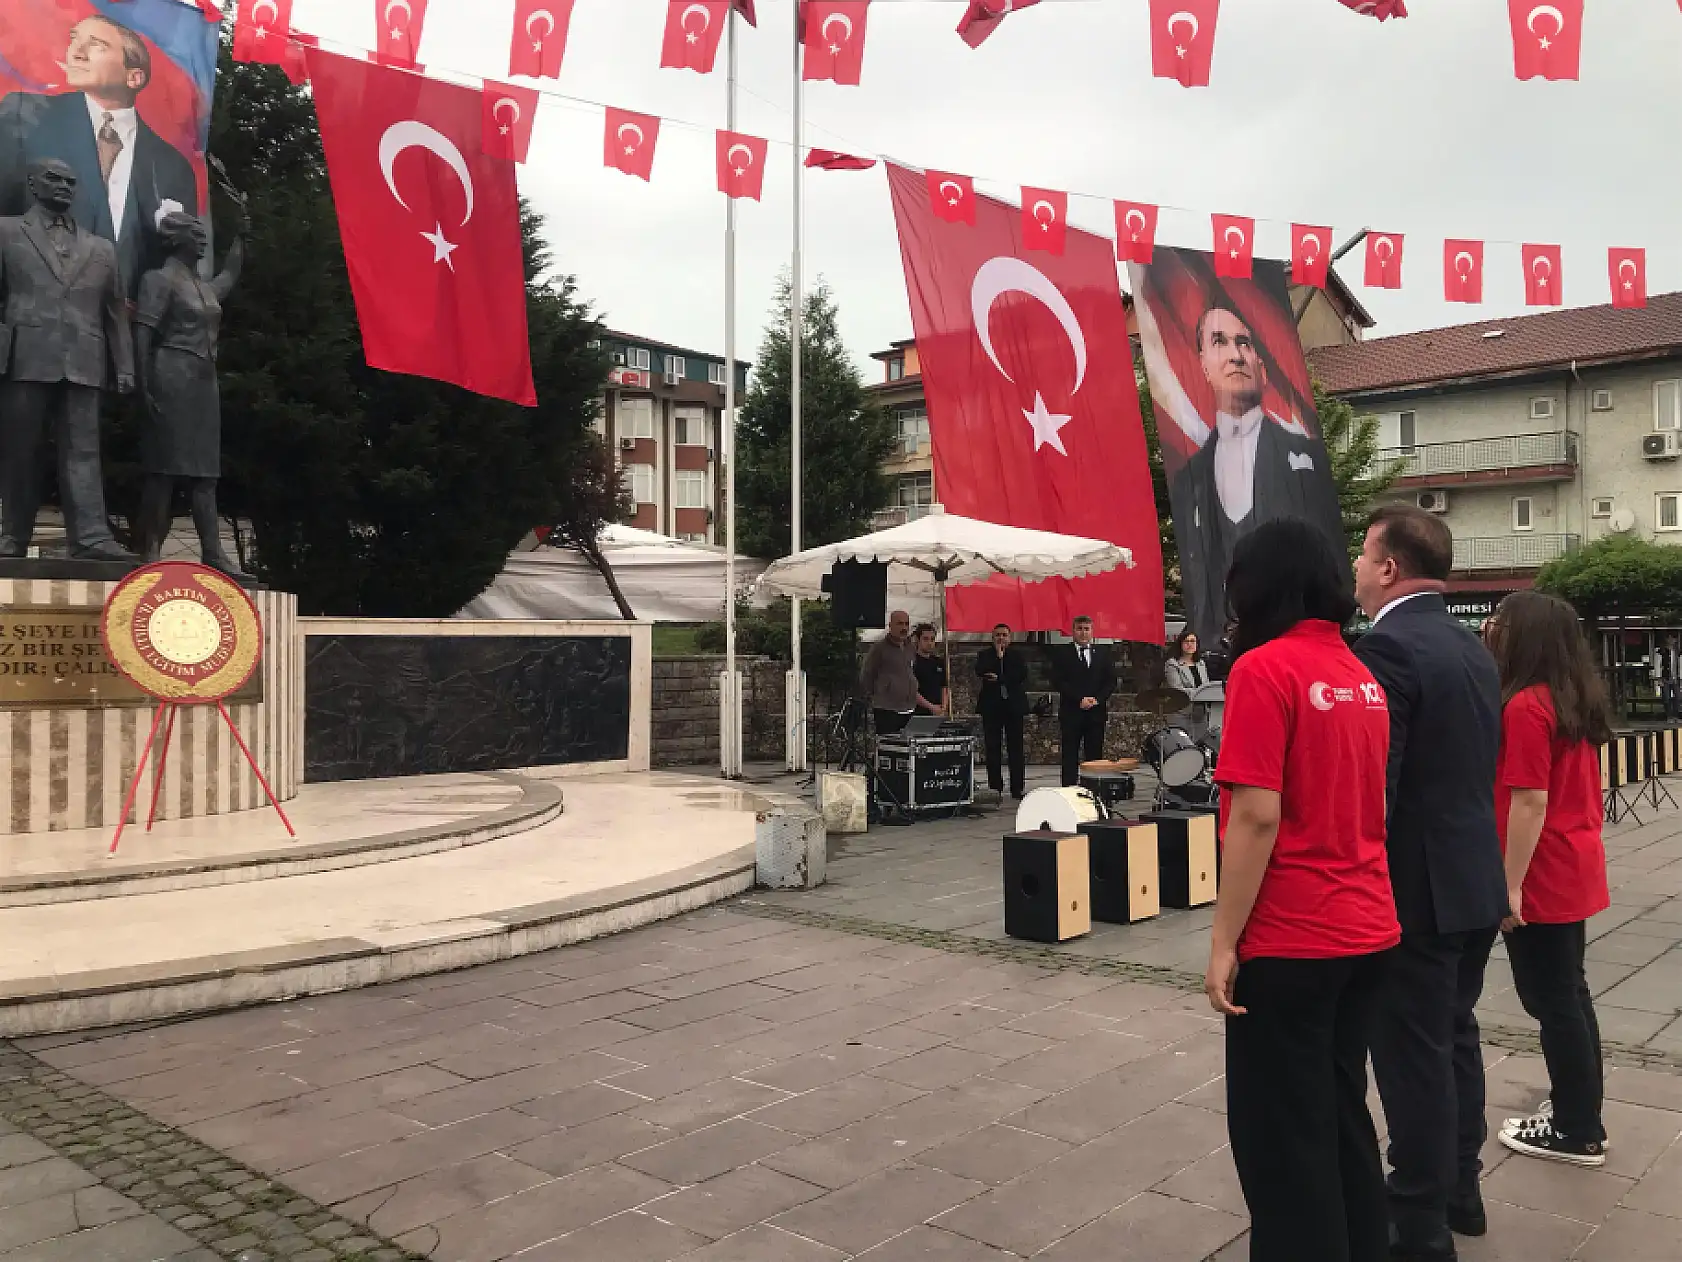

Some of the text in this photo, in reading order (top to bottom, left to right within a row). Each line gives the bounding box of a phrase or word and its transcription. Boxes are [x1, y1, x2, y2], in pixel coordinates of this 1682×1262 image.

[153, 588, 207, 602] BARTIN
[13, 624, 76, 640] ŞEYE
[23, 640, 64, 656] BİR
[72, 643, 107, 659] ŞE
